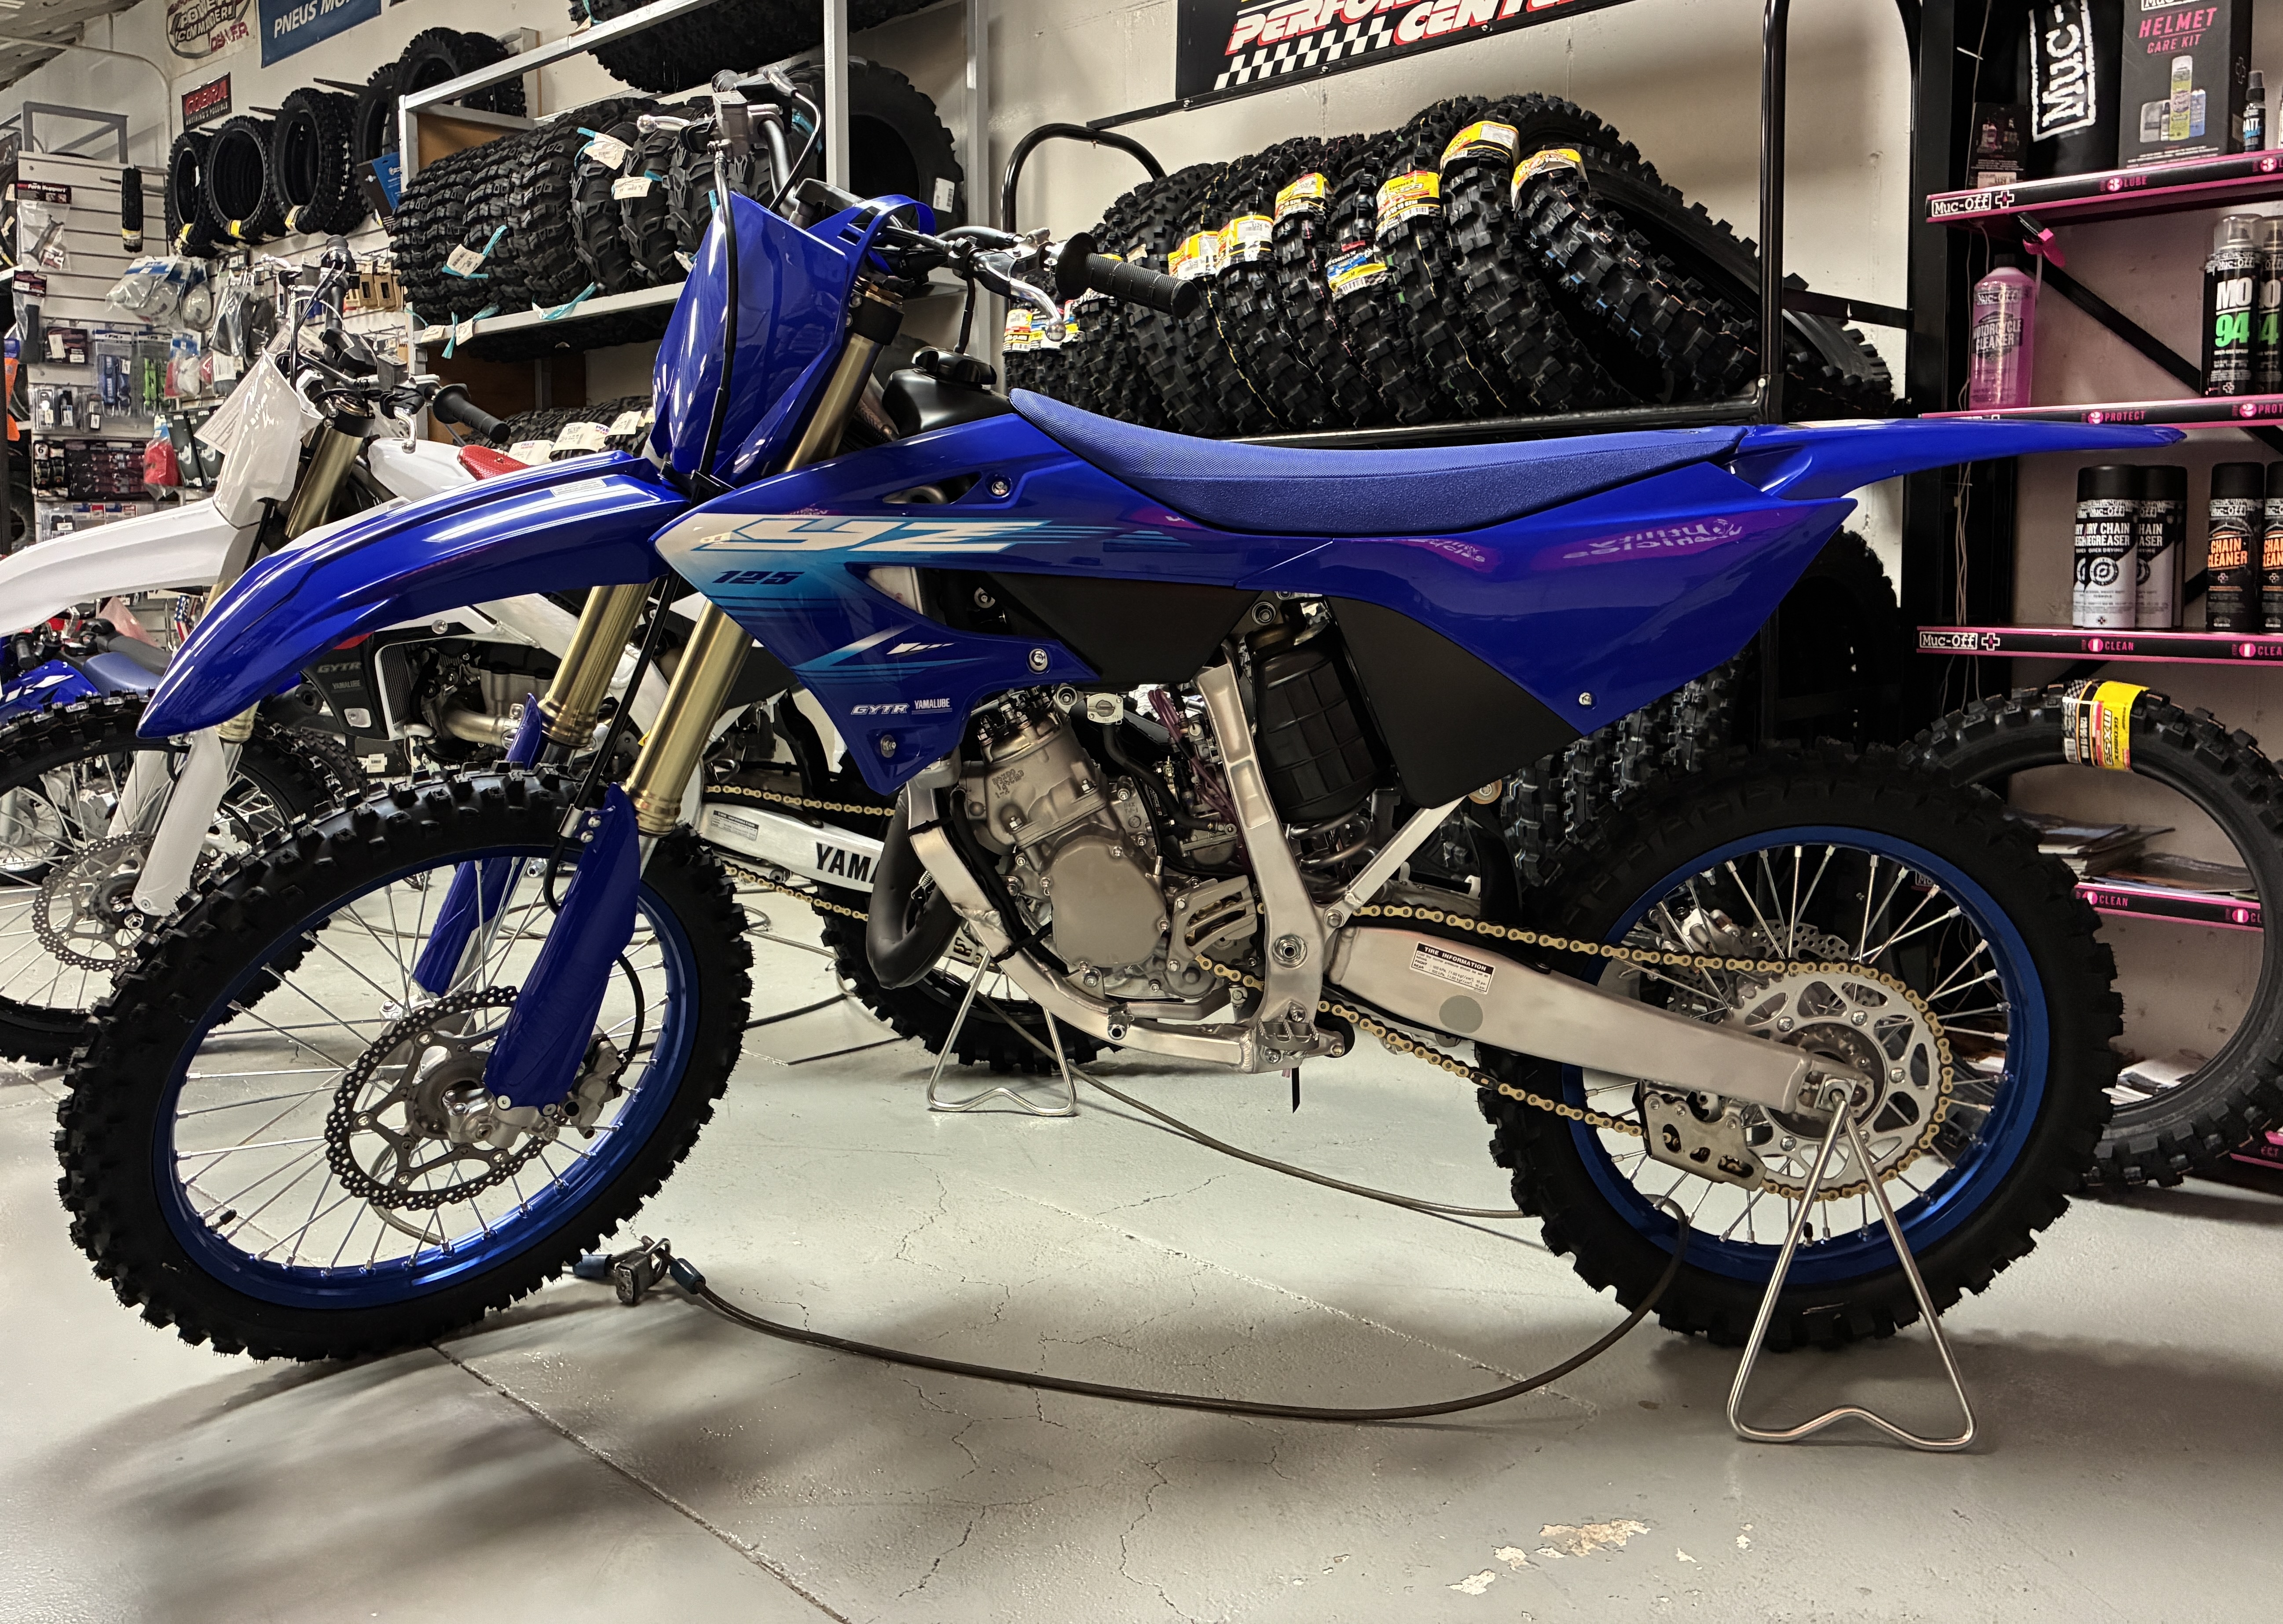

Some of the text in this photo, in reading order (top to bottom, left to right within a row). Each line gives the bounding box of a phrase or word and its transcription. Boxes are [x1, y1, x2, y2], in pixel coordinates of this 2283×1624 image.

[274, 0, 350, 39] PNEUS MO
[1225, 0, 1420, 55] PERFO
[1394, 0, 1576, 45] CEN
[2139, 7, 2217, 38] HELMET
[2147, 34, 2202, 54] CARE KIT
[2109, 176, 2147, 191] 3 LUBE
[1935, 195, 1990, 214] Muc-Off
[2216, 277, 2253, 311] MO
[2215, 312, 2250, 347] 94
[2104, 410, 2145, 423] PROTECT
[2100, 522, 2130, 535] CHAIN
[2139, 523, 2163, 535] HAIN
[2211, 538, 2242, 554] CHAIN
[2208, 550, 2248, 568] CLEANER
[712, 571, 805, 585] 125
[1922, 634, 1975, 648] Muc-Off
[2105, 639, 2134, 651] CLEAN
[317, 661, 362, 673] GYTR
[851, 698, 950, 715] GYTR YAMALUBE
[2099, 895, 2128, 907] CLEAN
[1425, 947, 1487, 971] TIRE INFORMATION
